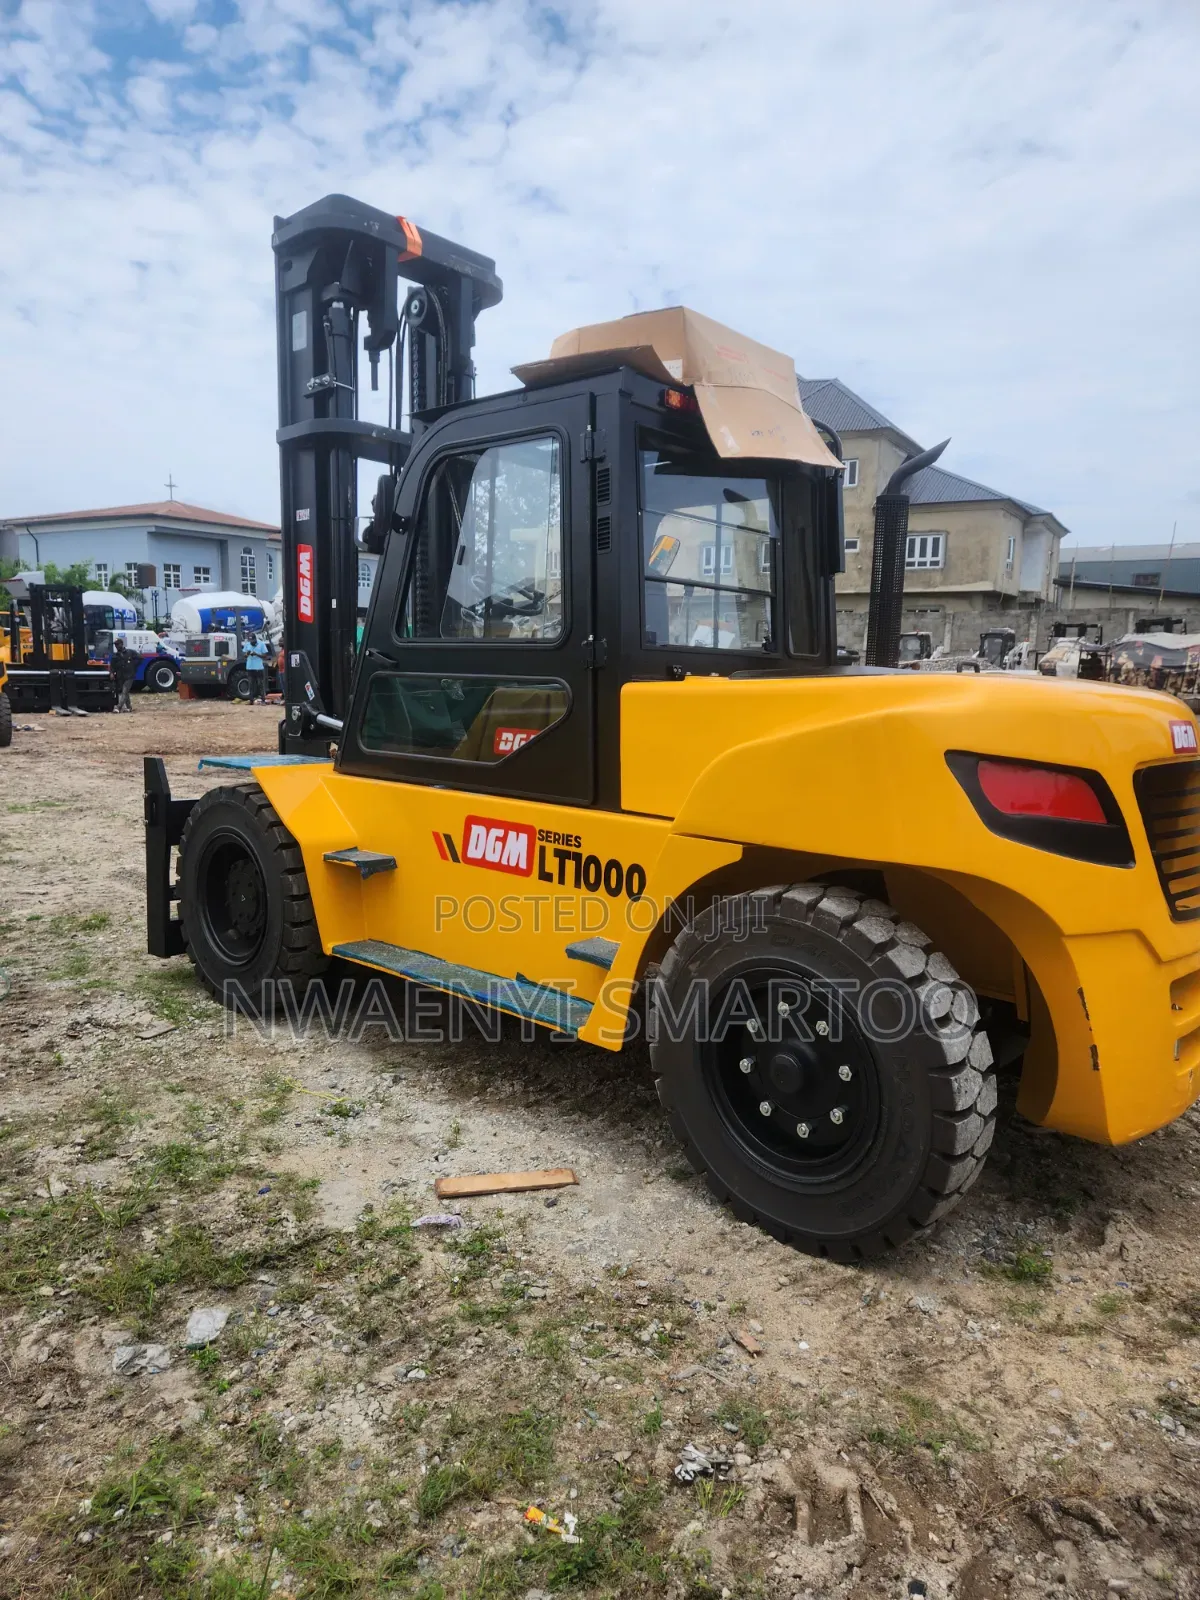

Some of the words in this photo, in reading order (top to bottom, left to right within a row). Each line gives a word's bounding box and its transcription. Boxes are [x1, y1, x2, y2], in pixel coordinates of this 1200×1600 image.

[300, 552, 311, 616] DGM
[499, 732, 536, 751] DG
[467, 825, 528, 869] DGM
[537, 829, 582, 848] SERIES
[538, 846, 647, 902] LT1000
